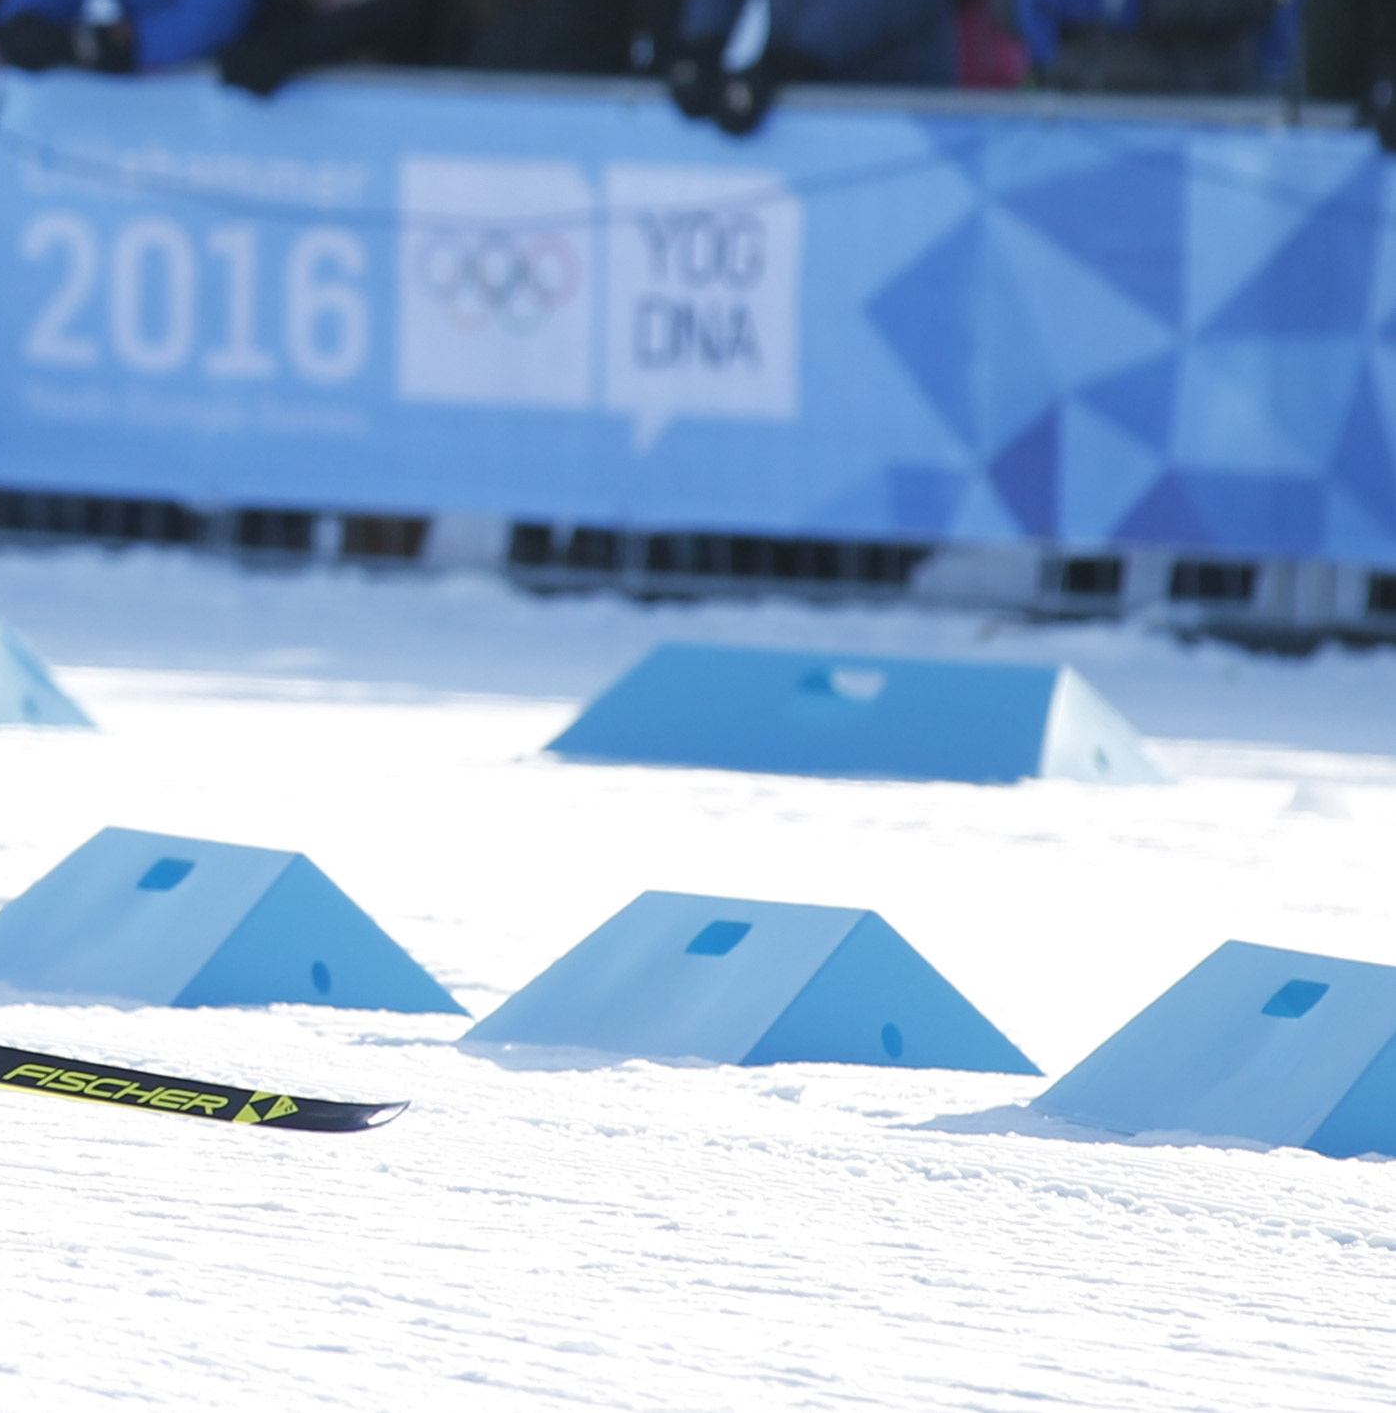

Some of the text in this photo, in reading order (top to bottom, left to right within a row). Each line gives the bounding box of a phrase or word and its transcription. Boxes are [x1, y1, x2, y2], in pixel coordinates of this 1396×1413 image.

[637, 210, 768, 294] YOG
[22, 213, 370, 381] 2016
[633, 297, 766, 371] DNA
[1, 1063, 230, 1116] FISCHER
